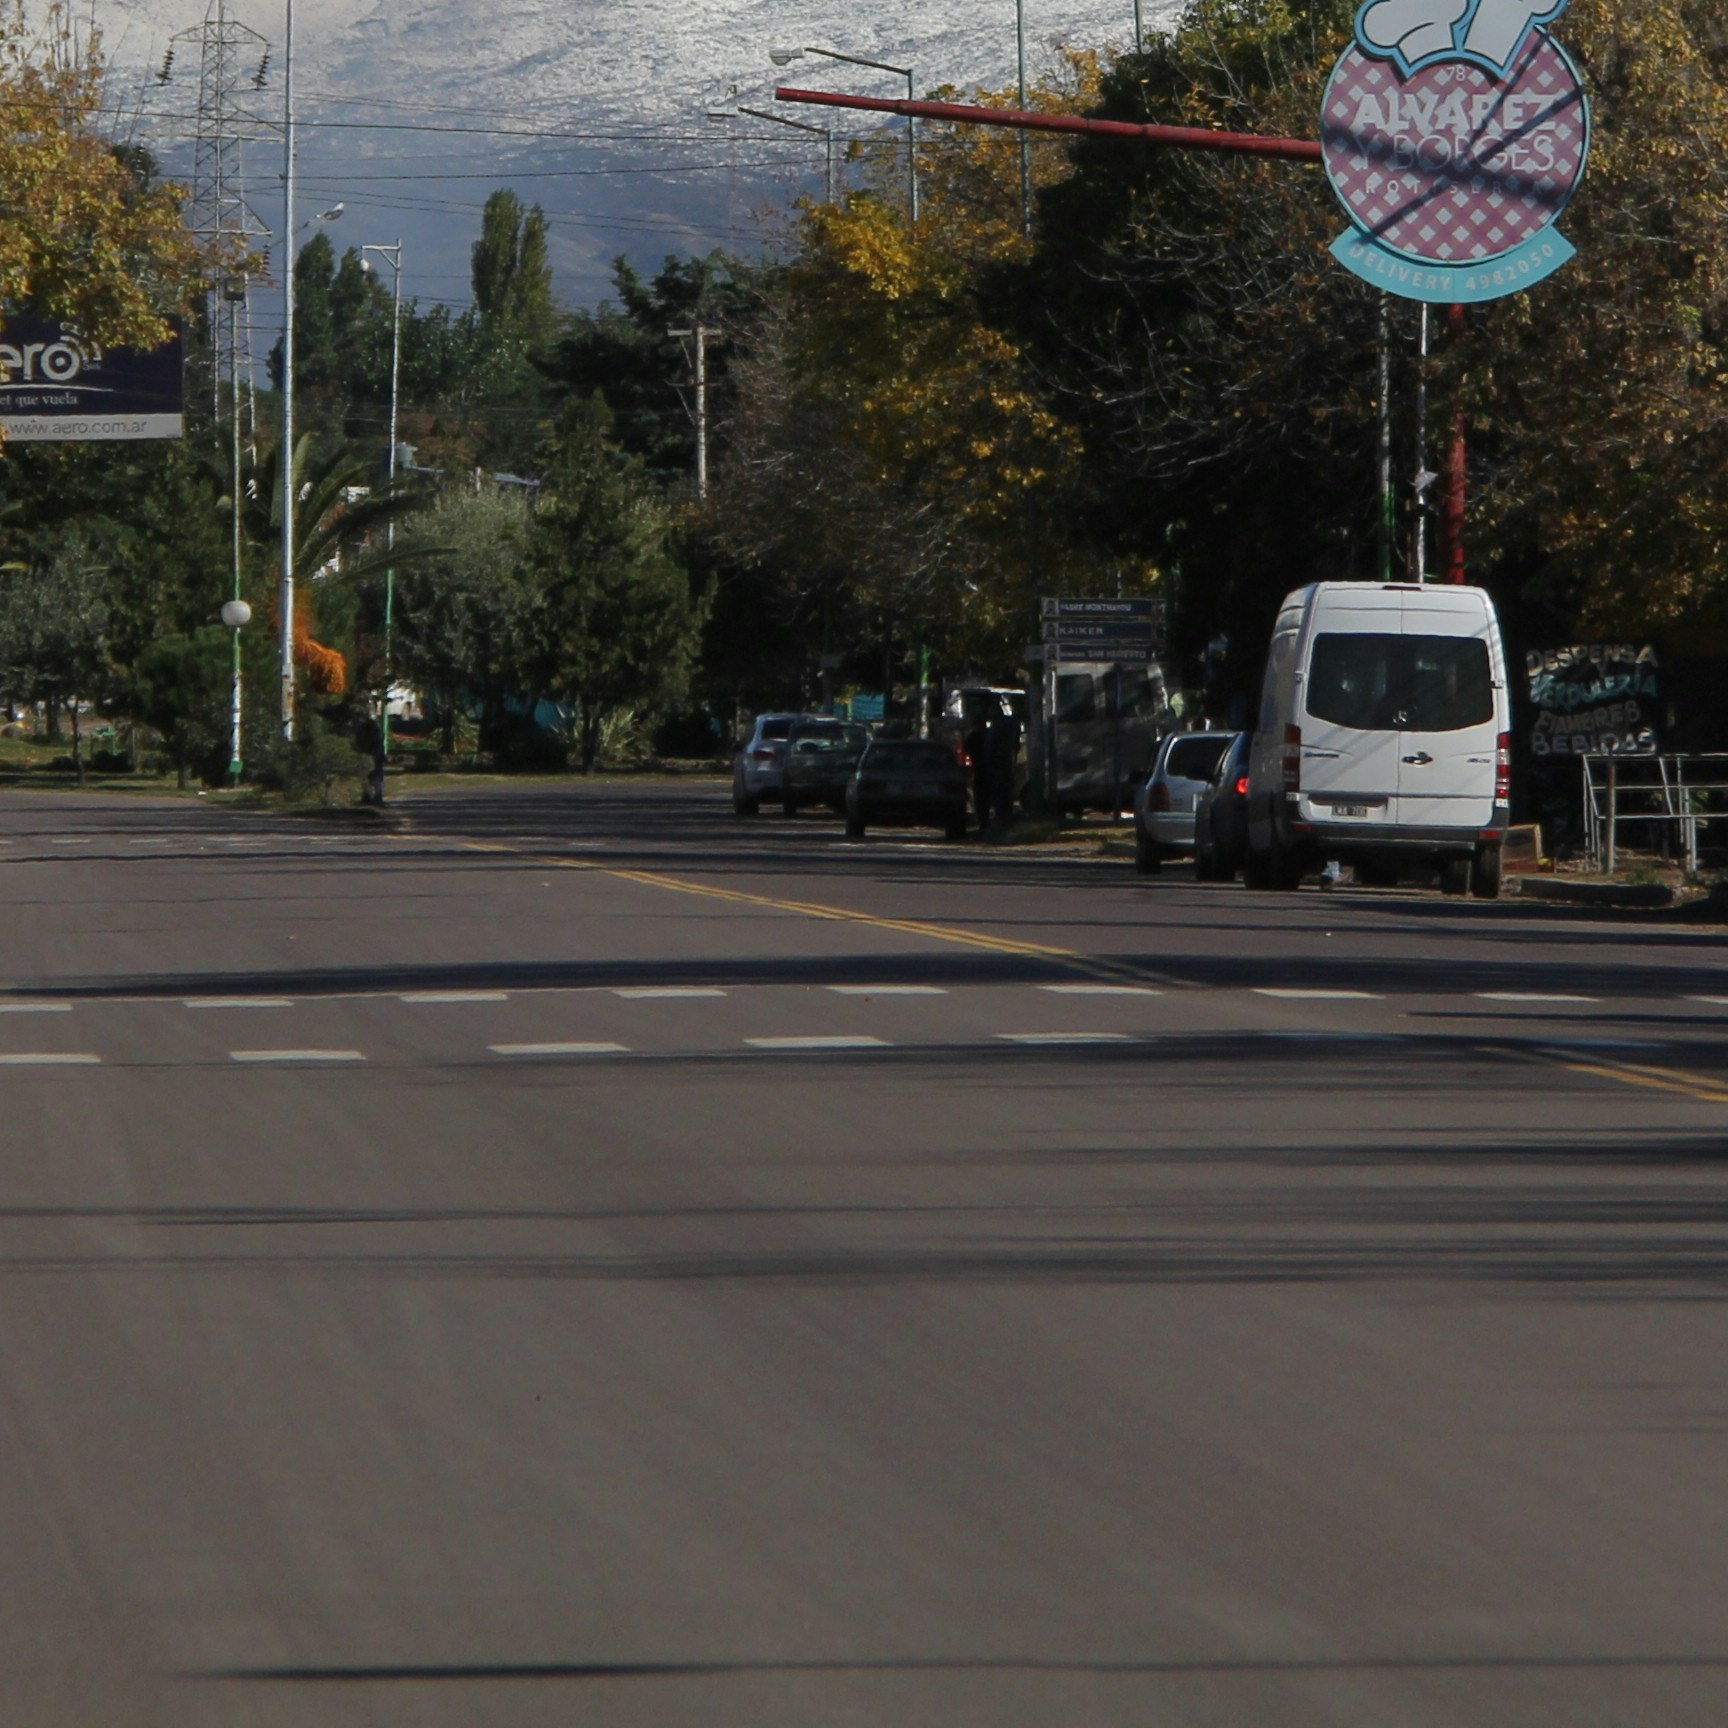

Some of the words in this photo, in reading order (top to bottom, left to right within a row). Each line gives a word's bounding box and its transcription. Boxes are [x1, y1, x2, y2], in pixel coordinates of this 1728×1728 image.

[1352, 92, 1557, 132] ALVAREZ
[1391, 134, 1555, 172] BORGES
[1348, 244, 1453, 292] DELIVERY
[1465, 243, 1555, 290] 4982050
[15, 395, 38, 411] que
[42, 392, 79, 406] vuela
[9, 419, 148, 436] www.aero.com.ar
[1525, 643, 1659, 678] DESPENSA
[1530, 726, 1659, 756] BEBIDAS
